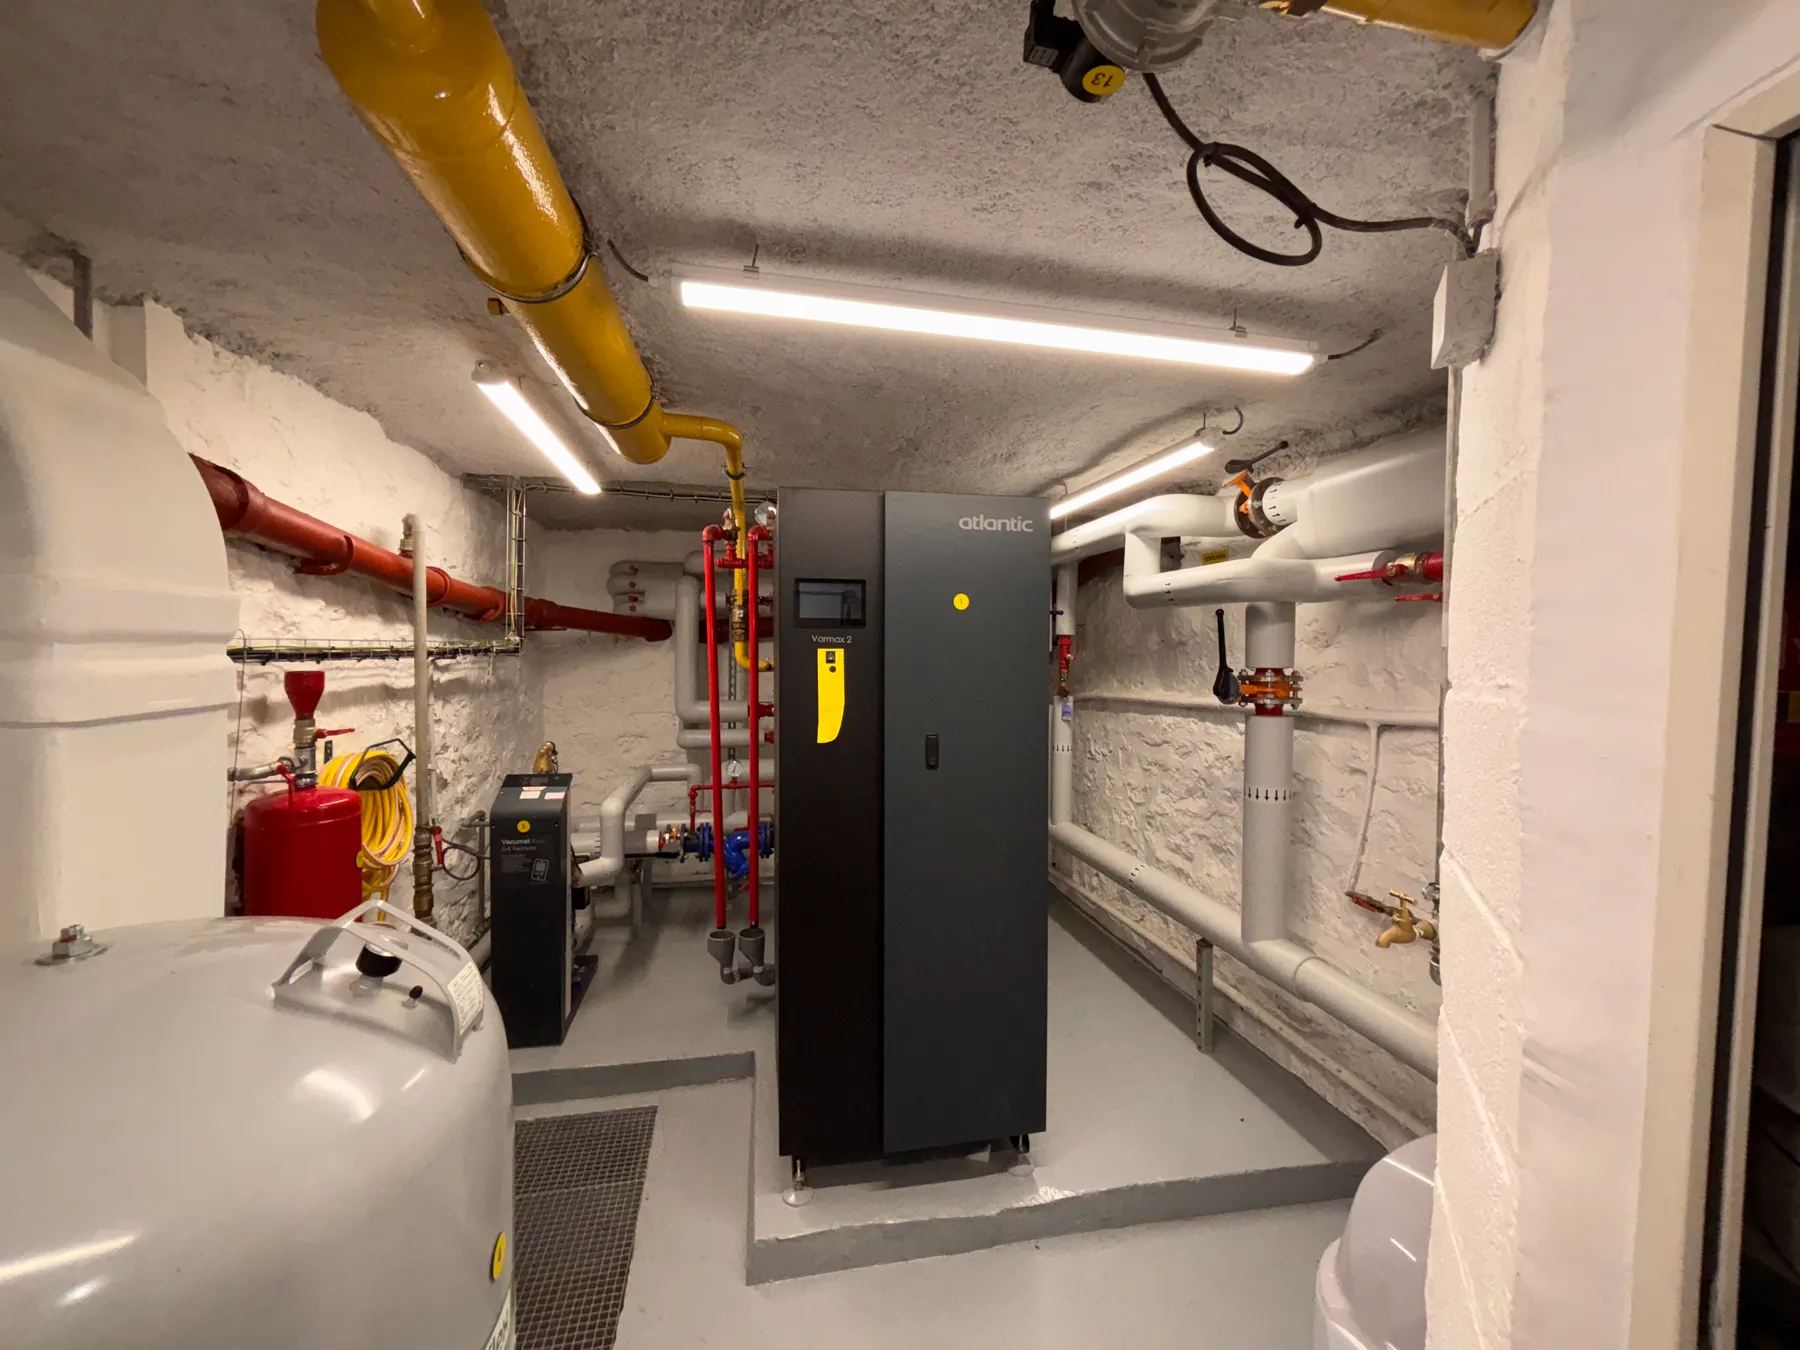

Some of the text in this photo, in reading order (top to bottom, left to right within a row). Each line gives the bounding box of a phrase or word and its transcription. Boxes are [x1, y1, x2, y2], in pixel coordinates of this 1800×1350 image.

[1091, 72, 1113, 88] 13
[958, 513, 1034, 533] atlantic
[811, 634, 853, 644] Varmax 2
